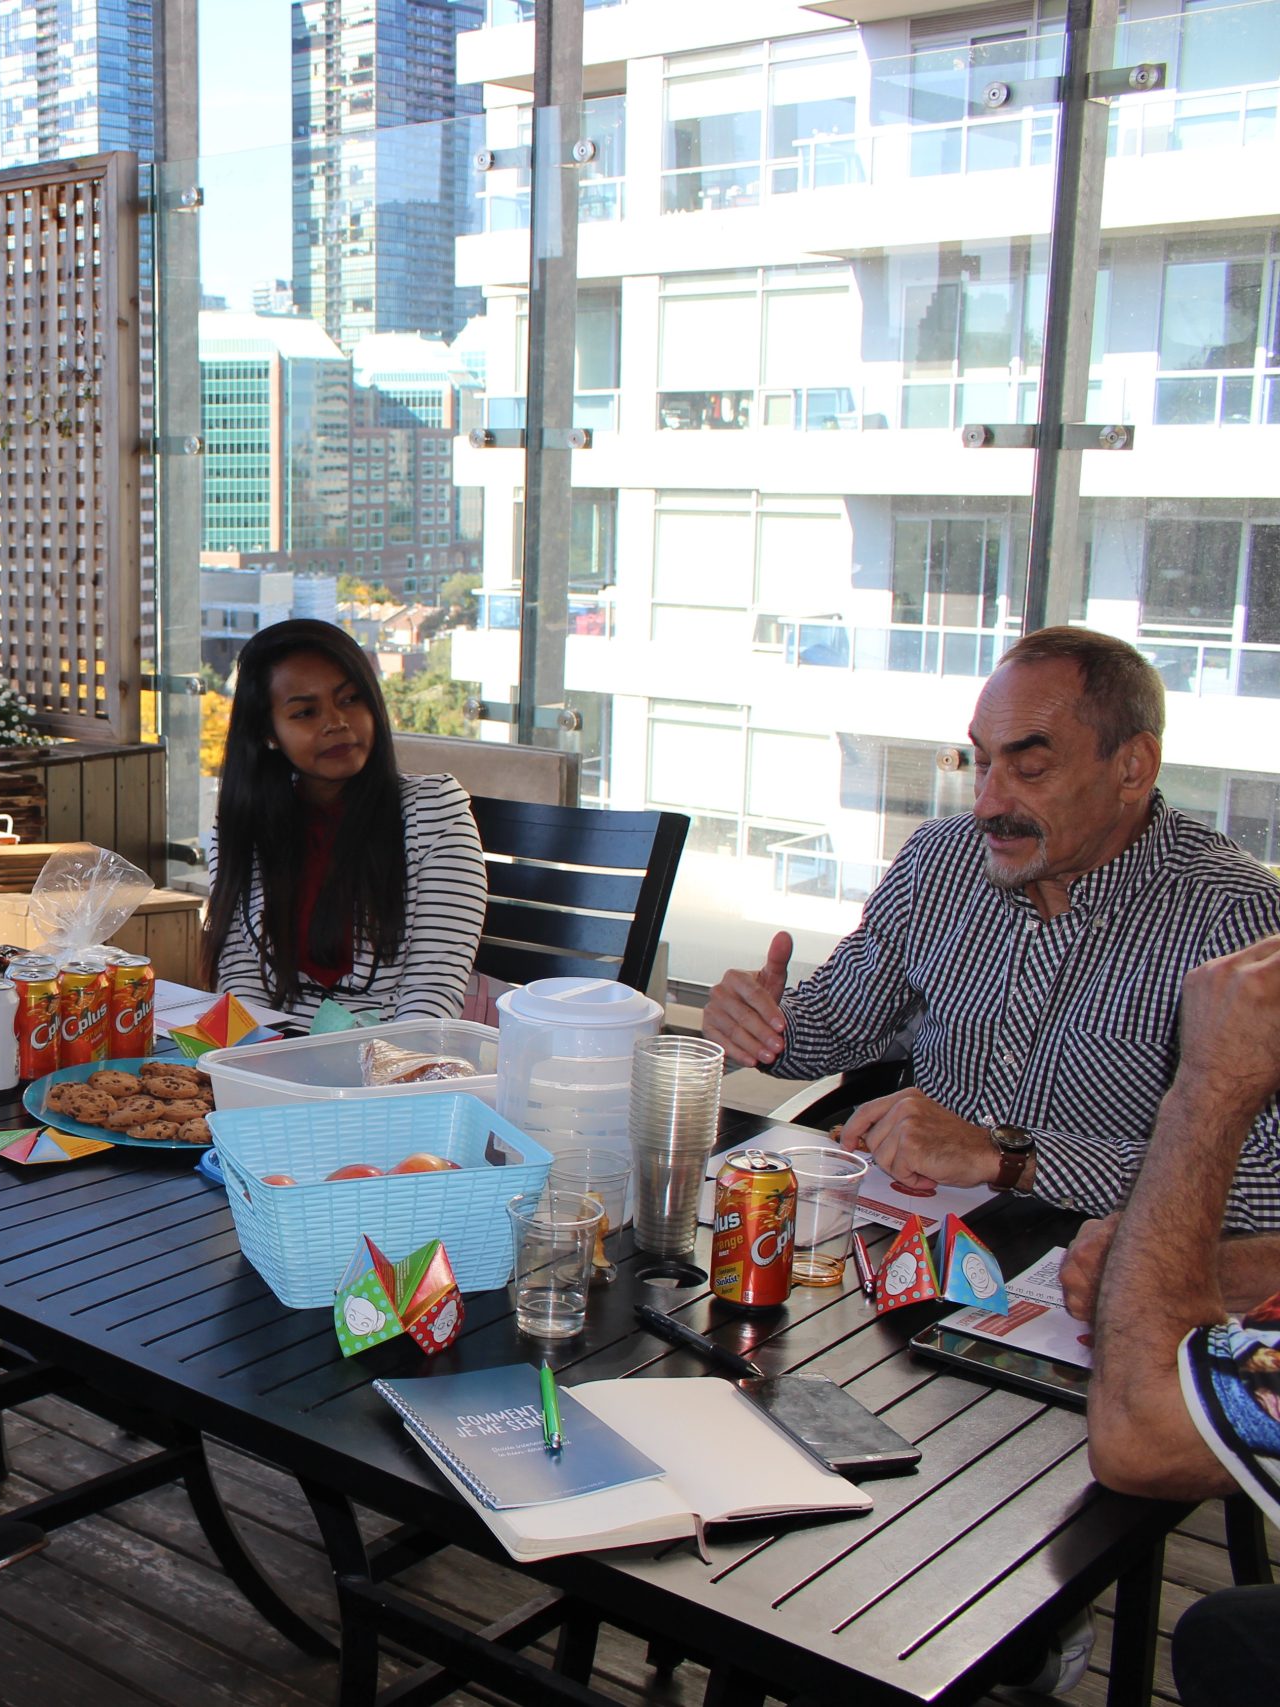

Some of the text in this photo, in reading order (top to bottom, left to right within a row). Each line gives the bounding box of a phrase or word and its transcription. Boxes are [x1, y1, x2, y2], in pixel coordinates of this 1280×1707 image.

[31, 1015, 61, 1050] Cpl
[62, 1003, 108, 1041] Cplus
[455, 1426, 478, 1439] JE
[477, 1421, 508, 1437] ME
[457, 1404, 540, 1428] COMMENT
